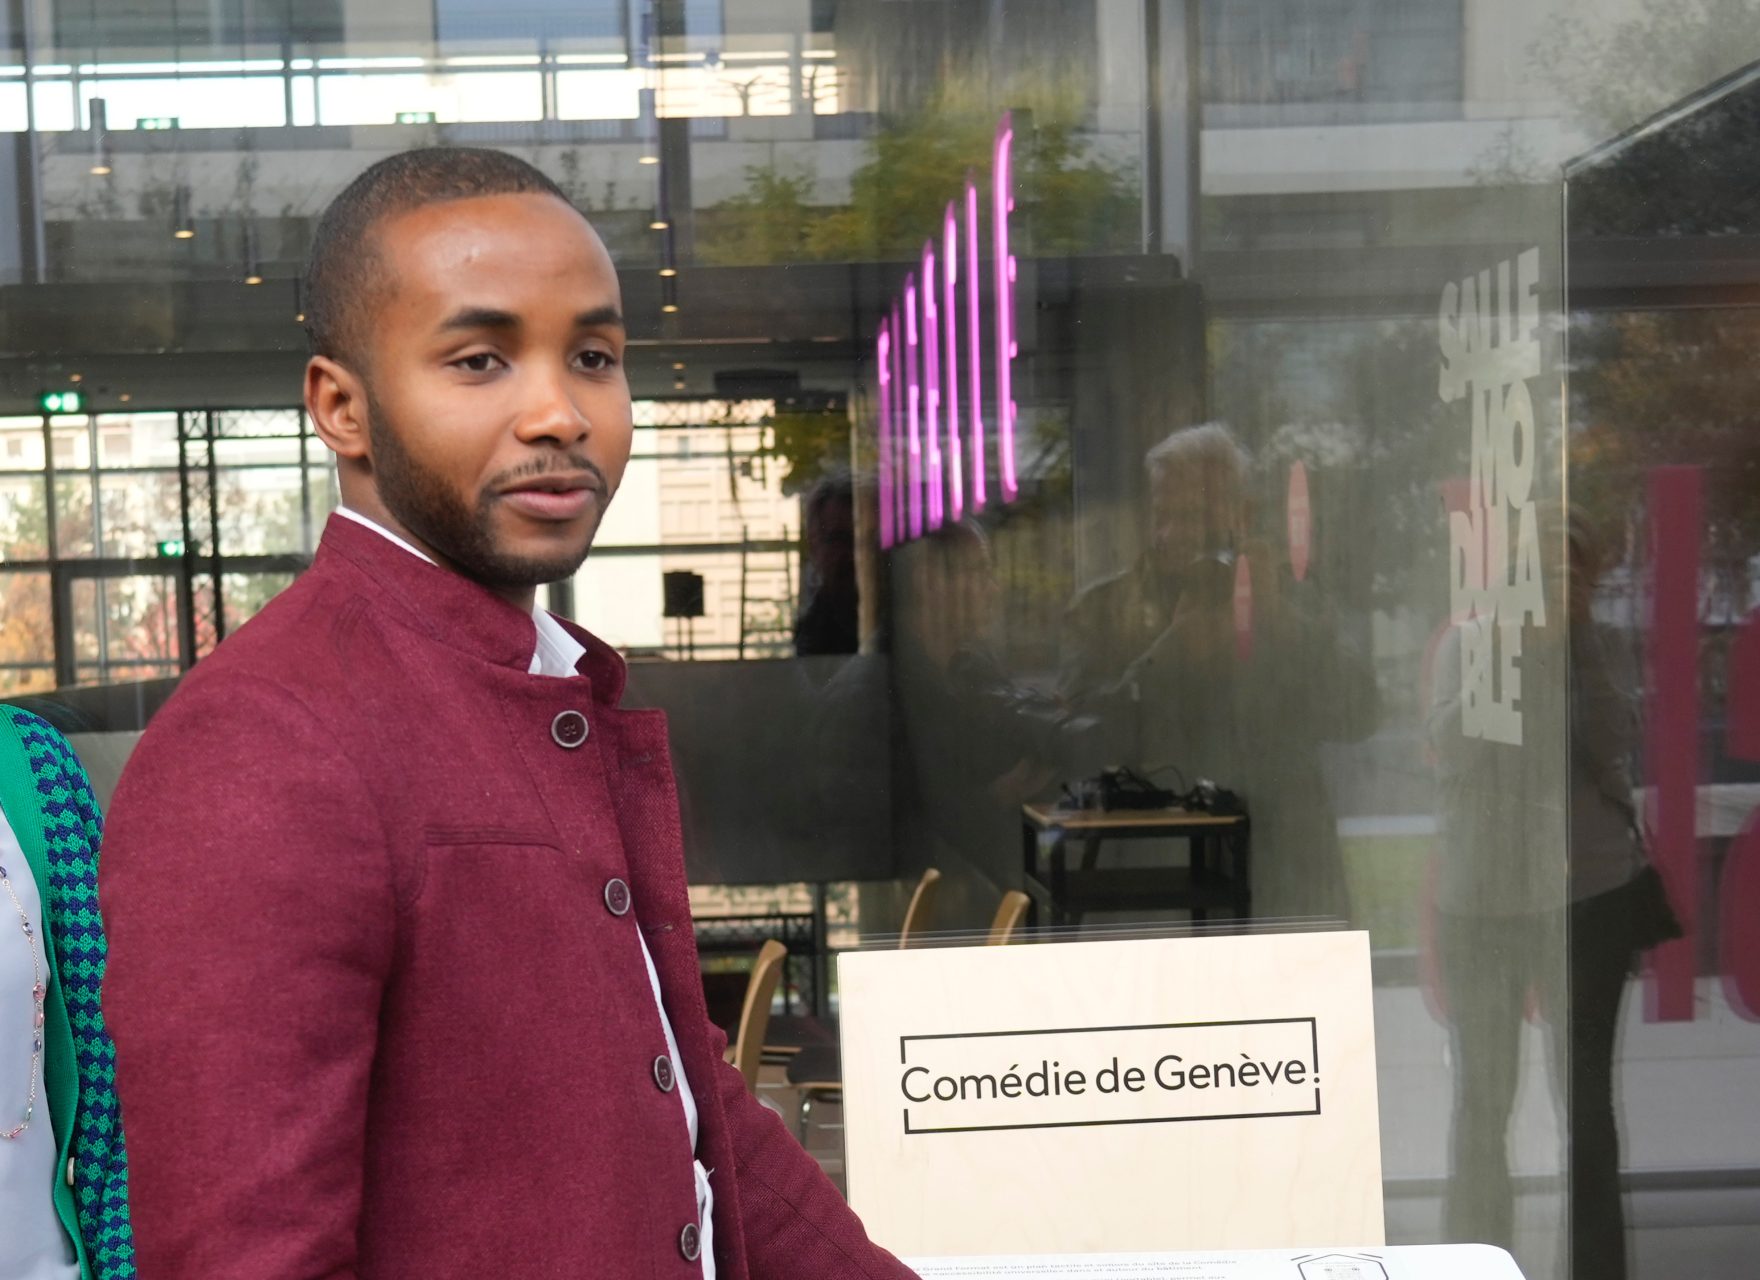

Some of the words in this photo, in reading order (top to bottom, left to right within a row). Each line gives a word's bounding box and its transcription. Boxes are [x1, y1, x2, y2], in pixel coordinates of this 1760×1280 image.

[1438, 247, 1540, 403] SALLE
[1471, 378, 1535, 509] MO
[901, 1059, 1087, 1103] Comédie
[1095, 1056, 1146, 1093] de
